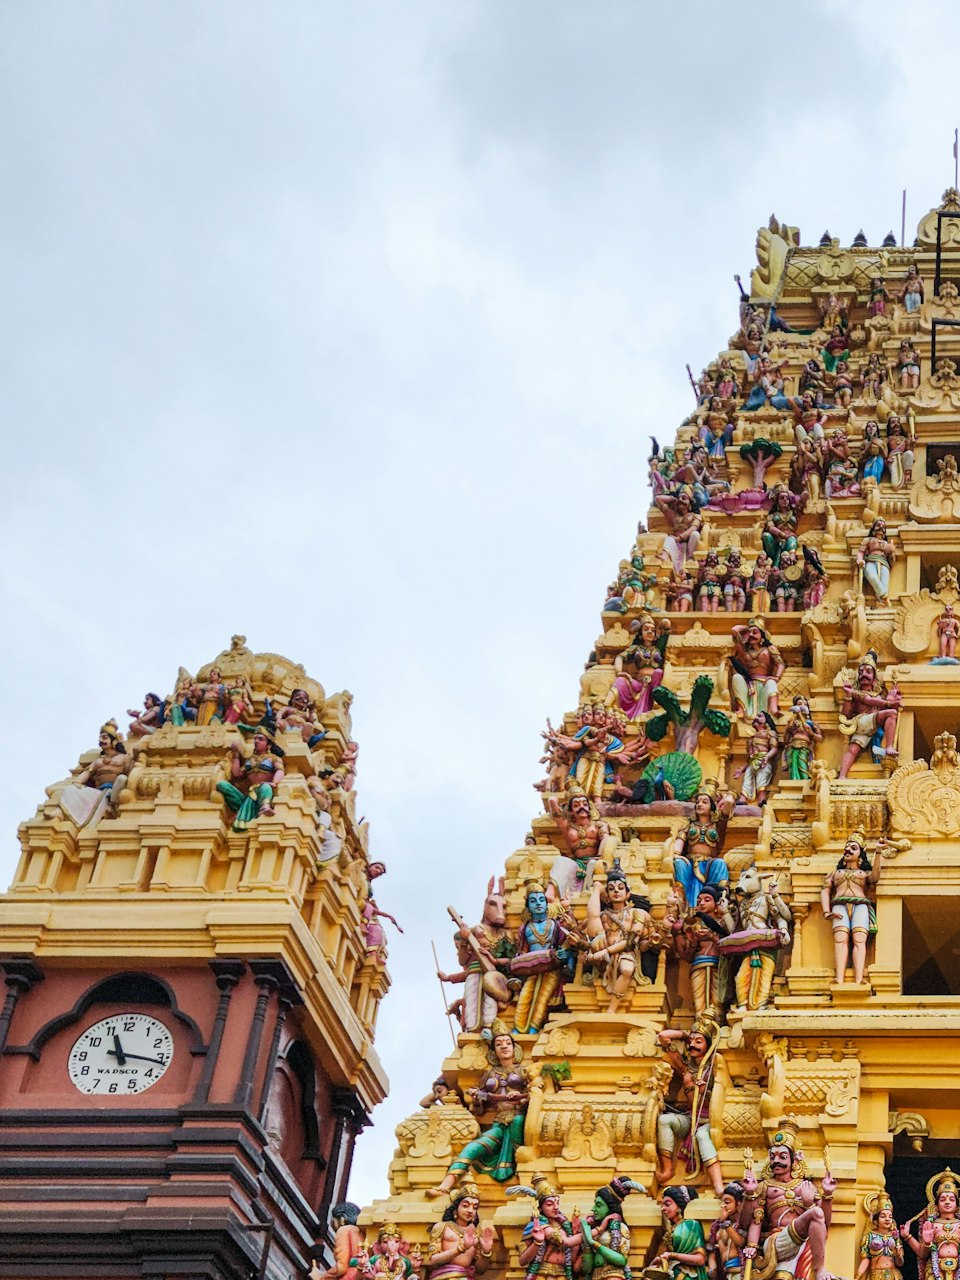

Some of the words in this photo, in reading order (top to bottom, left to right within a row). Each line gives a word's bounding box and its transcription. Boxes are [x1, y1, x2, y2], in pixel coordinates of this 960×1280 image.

[106, 1026, 116, 1036] 11
[123, 1022, 135, 1032] 12
[146, 1027, 151, 1037] 1
[89, 1037, 102, 1047] 10
[153, 1039, 163, 1049] 2
[78, 1052, 88, 1061] 9
[156, 1052, 165, 1062] 3
[81, 1066, 90, 1076] 8
[144, 1068, 153, 1078] 4
[93, 1079, 101, 1089] 7
[108, 1083, 118, 1093] 6
[127, 1079, 137, 1089] 5
